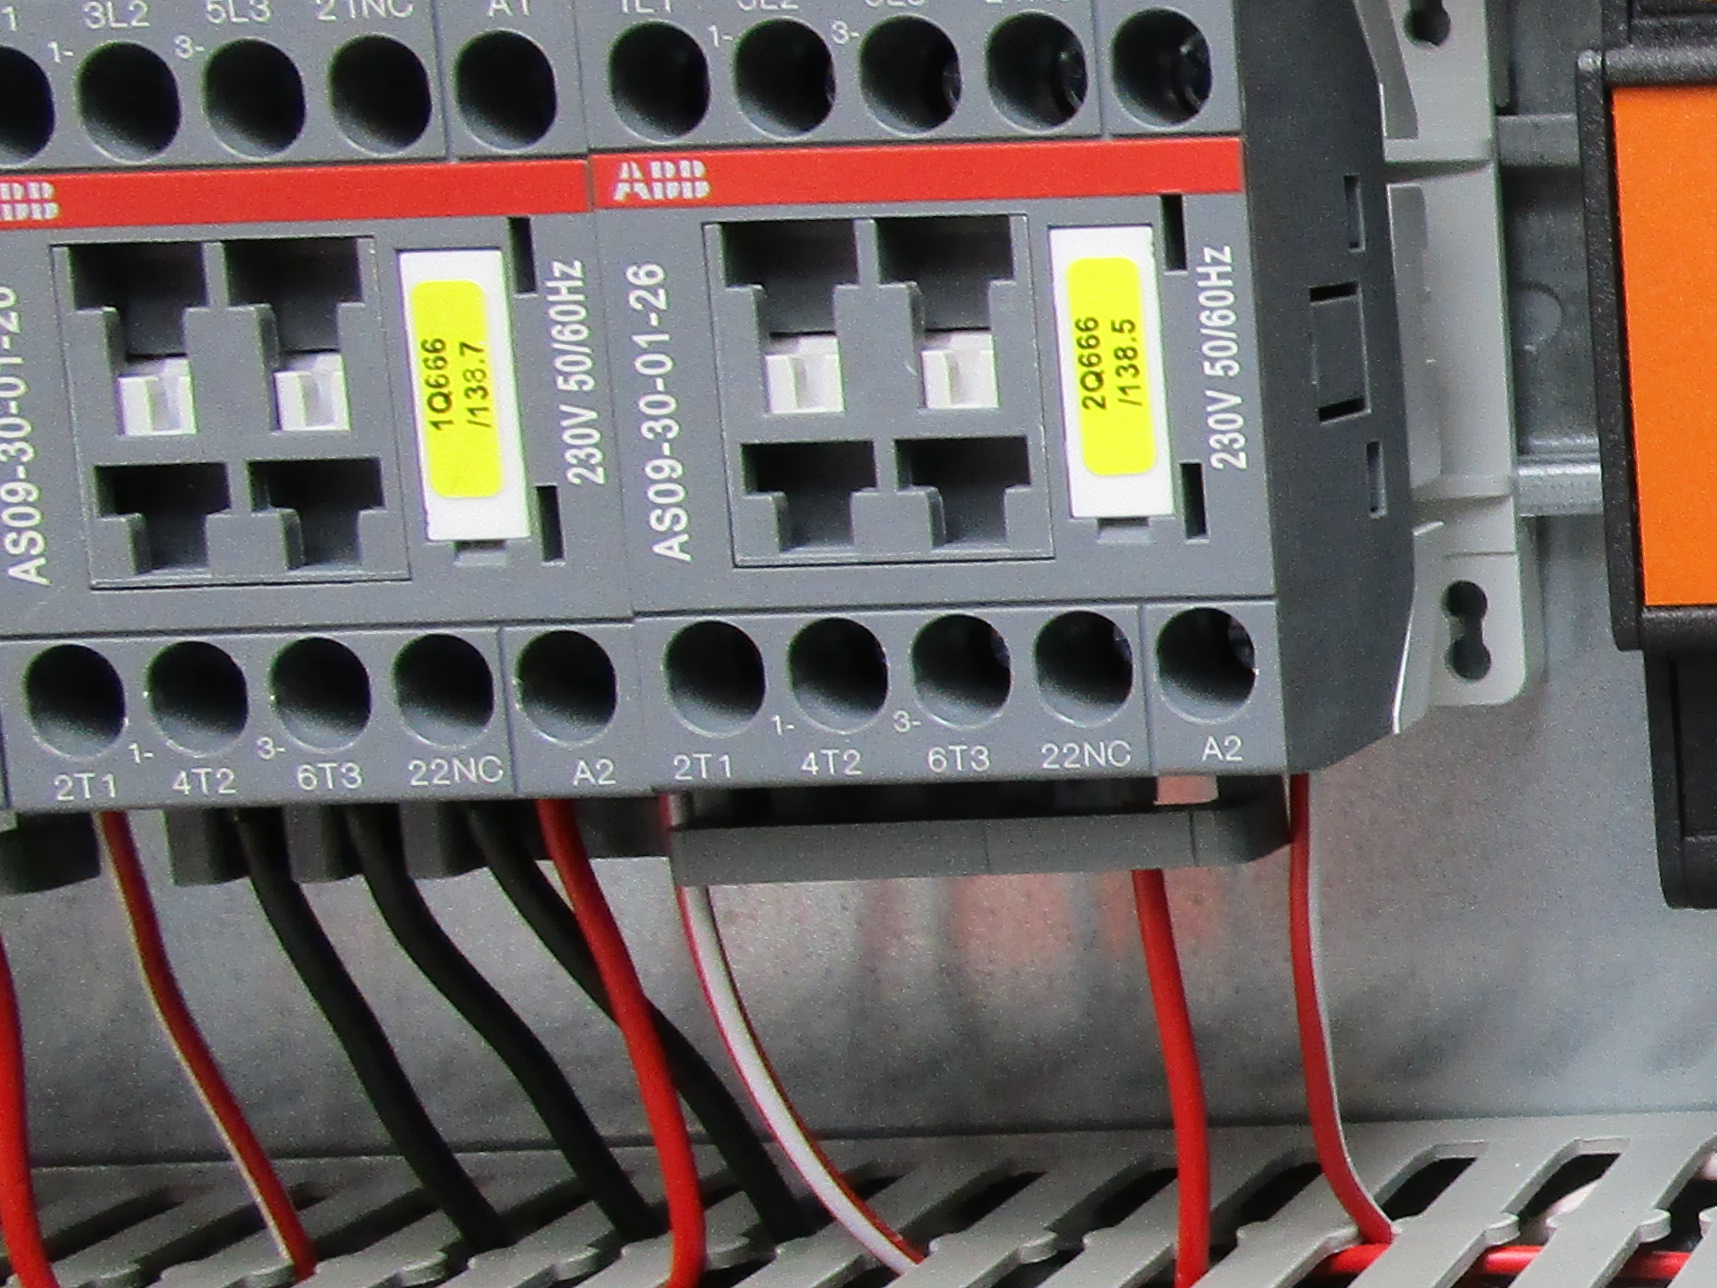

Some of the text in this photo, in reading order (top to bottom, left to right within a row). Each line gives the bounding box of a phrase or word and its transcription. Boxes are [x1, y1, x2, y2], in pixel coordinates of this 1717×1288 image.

[84, 0, 150, 29] 3L2
[0, 181, 60, 222] BB
[613, 158, 711, 202] ABB
[421, 336, 456, 433] 1Q666
[457, 340, 493, 430] /138.7
[549, 258, 607, 487] 230V 50/60Hz
[1073, 316, 1107, 412] 2Q666
[1109, 317, 1143, 408] /138.5
[1195, 244, 1250, 471] 230V 50/60Hz
[626, 263, 692, 564] AS09-30-01-26
[54, 756, 618, 801] 2T1 4T2 6T3 22NC A2
[673, 735, 1244, 781] 2T1 4T2 6T3 22NC A2
